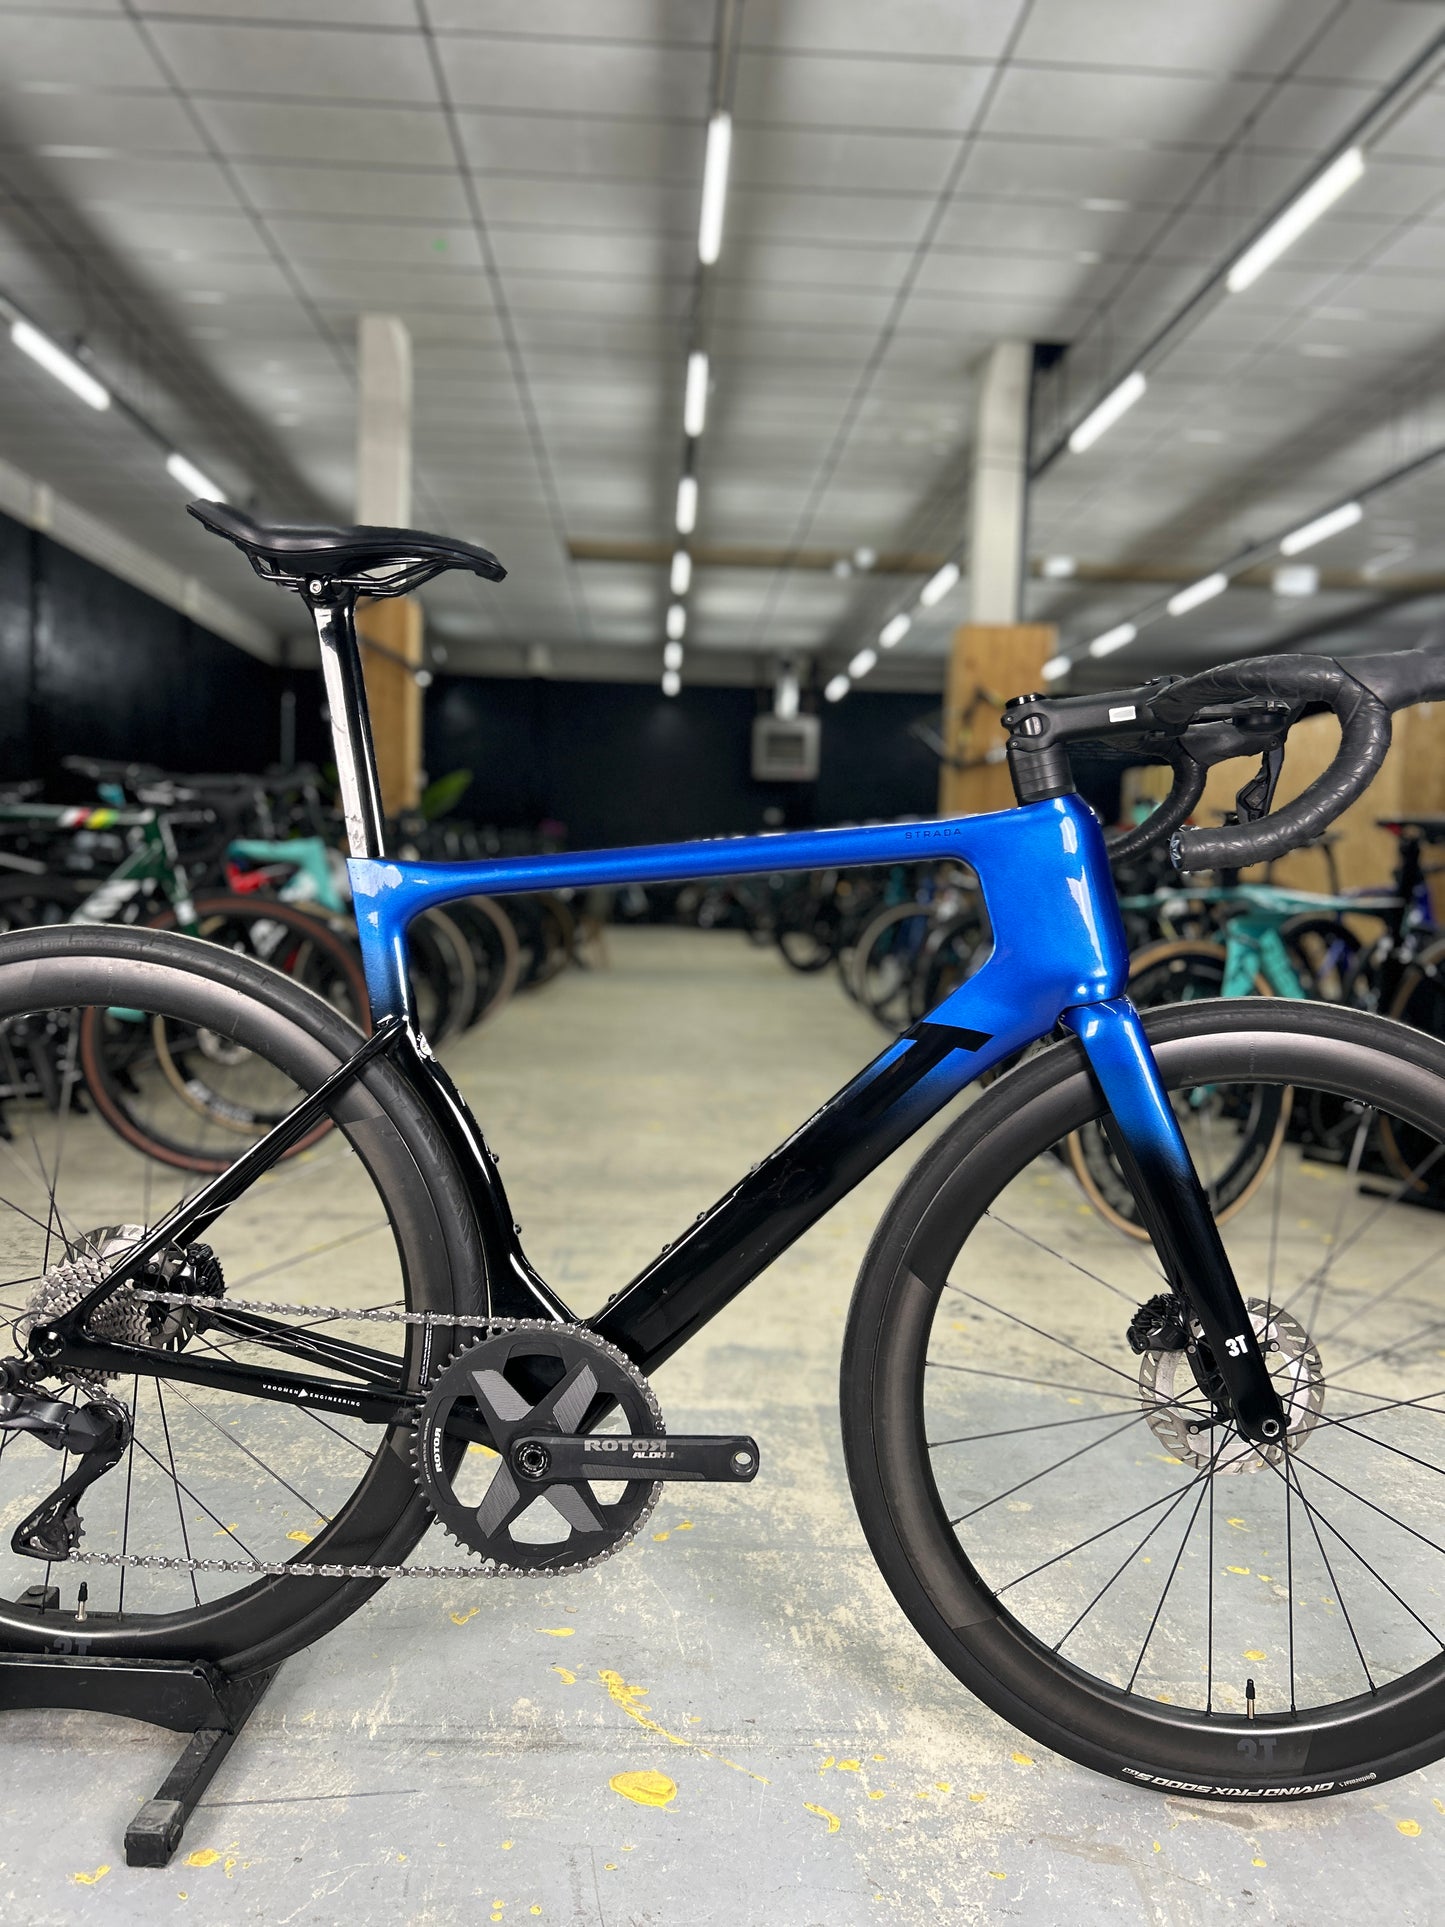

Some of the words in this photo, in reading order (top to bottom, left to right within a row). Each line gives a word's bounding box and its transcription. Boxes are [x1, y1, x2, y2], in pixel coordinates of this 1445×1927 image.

[905, 828, 961, 839] STRADA
[1225, 1334, 1248, 1357] 3T
[263, 1384, 299, 1394] VROOMEN
[309, 1392, 360, 1407] ENGINEERING
[433, 1427, 443, 1473] ROTOR
[584, 1439, 667, 1452] ROTOR
[1151, 1776, 1213, 1795] 5000
[1210, 1786, 1261, 1797] PRIX
[1262, 1782, 1335, 1797] GRAND
